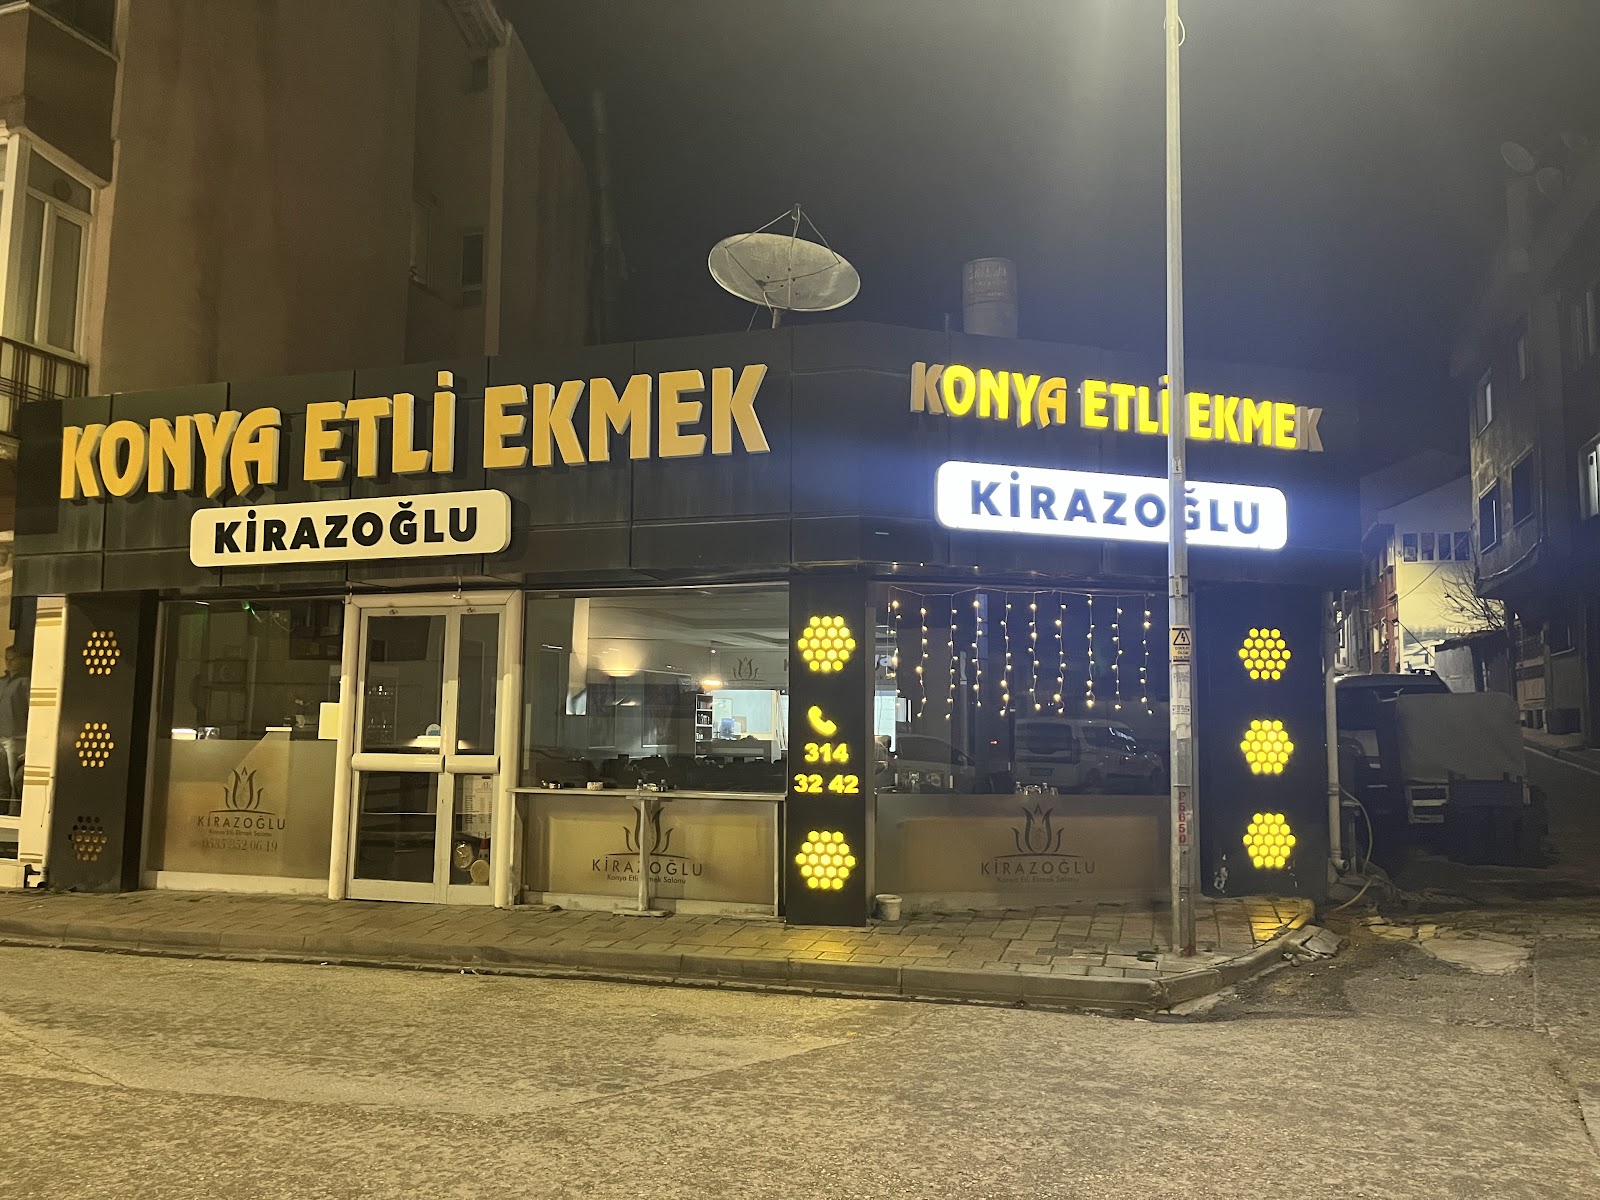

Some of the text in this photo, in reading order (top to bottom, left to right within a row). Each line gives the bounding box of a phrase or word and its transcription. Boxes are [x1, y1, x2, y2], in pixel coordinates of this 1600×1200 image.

[910, 361, 1068, 430] KONYA
[1184, 391, 1324, 452] EKMEK
[60, 364, 770, 500] KONYA ETLİ EKMEK
[214, 501, 477, 554] KİRAZOĞLU
[804, 742, 849, 763] 314
[793, 773, 859, 794] 32 42
[592, 856, 703, 877] KİRAOĞLU
[981, 859, 1096, 875] KİRAZOĞLU
[663, 876, 686, 884] Salonu
